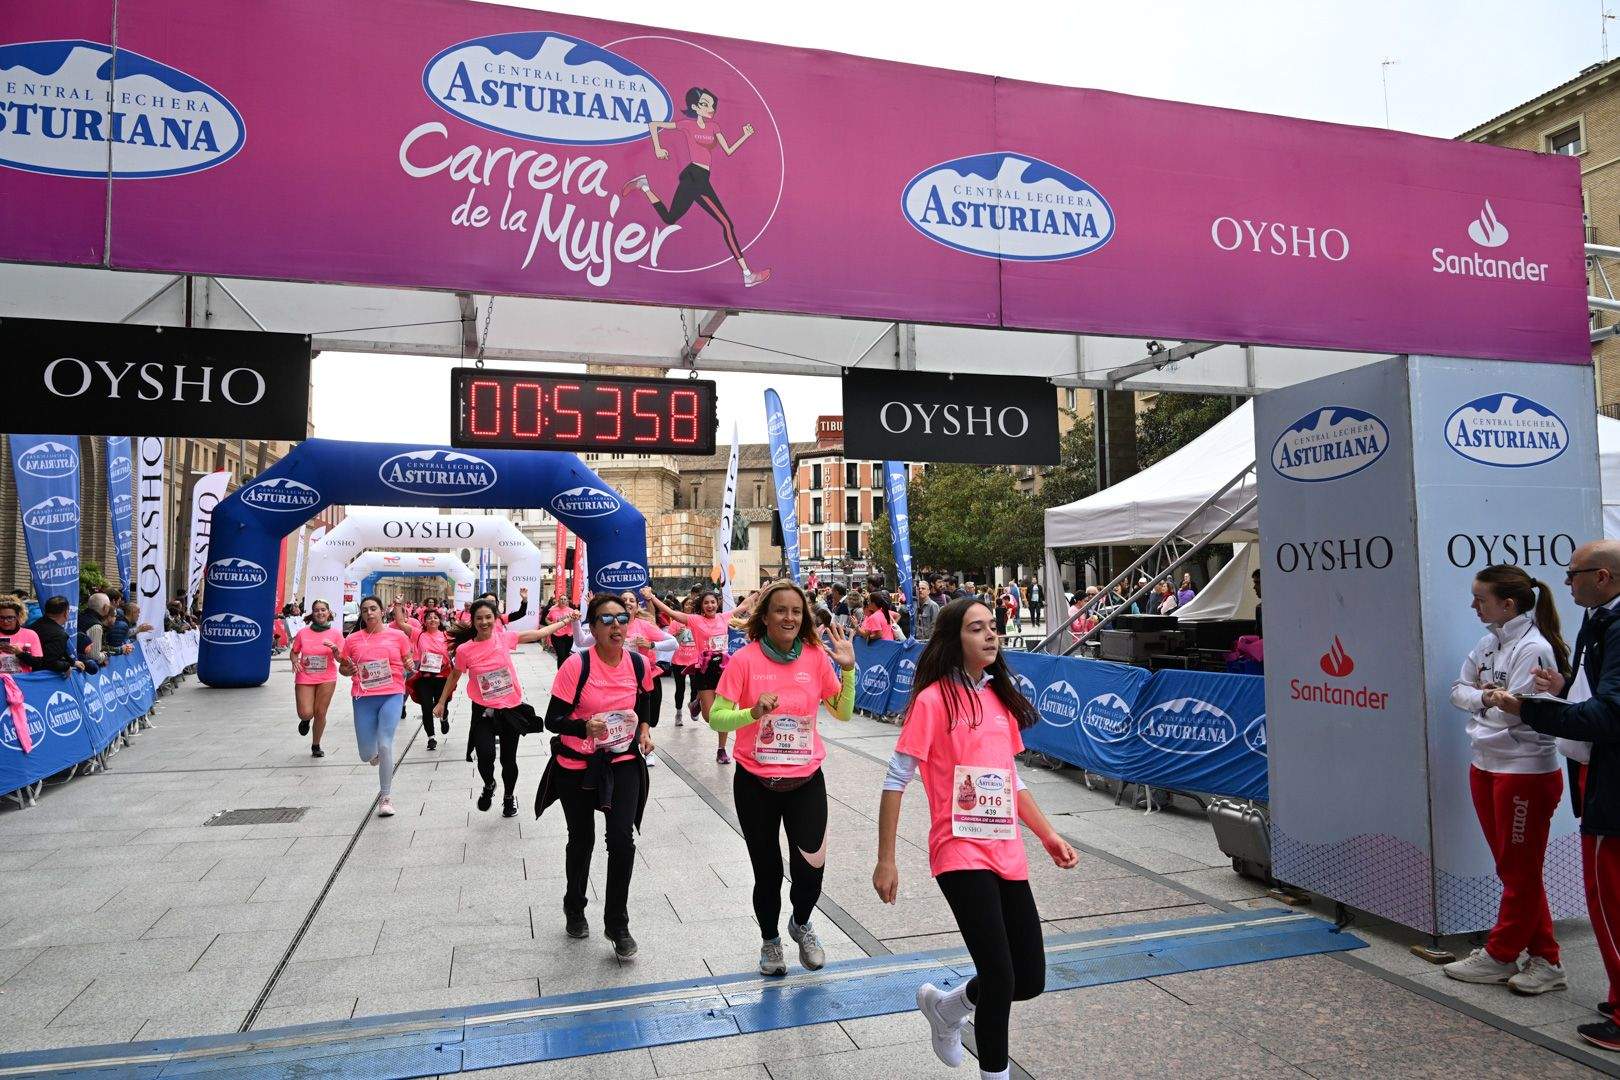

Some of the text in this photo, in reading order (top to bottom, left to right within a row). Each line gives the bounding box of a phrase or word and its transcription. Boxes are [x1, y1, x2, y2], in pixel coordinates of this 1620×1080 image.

[443, 61, 654, 125] ASTURIANA
[483, 61, 648, 94] CENTRAL LECHERA
[105, 91, 211, 113] LECHERA
[398, 121, 608, 197] Carrera
[451, 188, 527, 232] de la
[919, 184, 1101, 239] ASTURIANA
[953, 184, 1093, 208] CENTRAL LECHERA
[521, 193, 682, 287] Mujer
[1210, 216, 1350, 261] OYSHO
[1431, 247, 1549, 281] Santander
[43, 357, 266, 406] OYSHO
[879, 400, 1029, 439] OYSHO
[1294, 424, 1374, 445] CENTRAL LECHERA
[1454, 418, 1561, 450] ASTURIANA
[1472, 417, 1556, 428] CENTRAL LECHERA
[1278, 435, 1380, 469] ASTURIANA
[388, 462, 489, 486] ASTURIANA
[245, 490, 314, 505] ASTURIANA
[557, 498, 616, 511] ASTURIANA
[140, 437, 163, 599] OYSHO
[383, 520, 475, 539] OYSHO
[1276, 535, 1394, 573] OYSHO
[1447, 533, 1576, 568] OYSHO
[208, 568, 263, 582] ASTURIANA
[599, 571, 645, 583] ASTURIANA
[203, 623, 256, 637] ASTURIANA
[1290, 678, 1389, 710] Santander
[776, 733, 795, 741] 016
[1140, 715, 1227, 744] ASTURIANA
[978, 795, 1002, 806] 016
